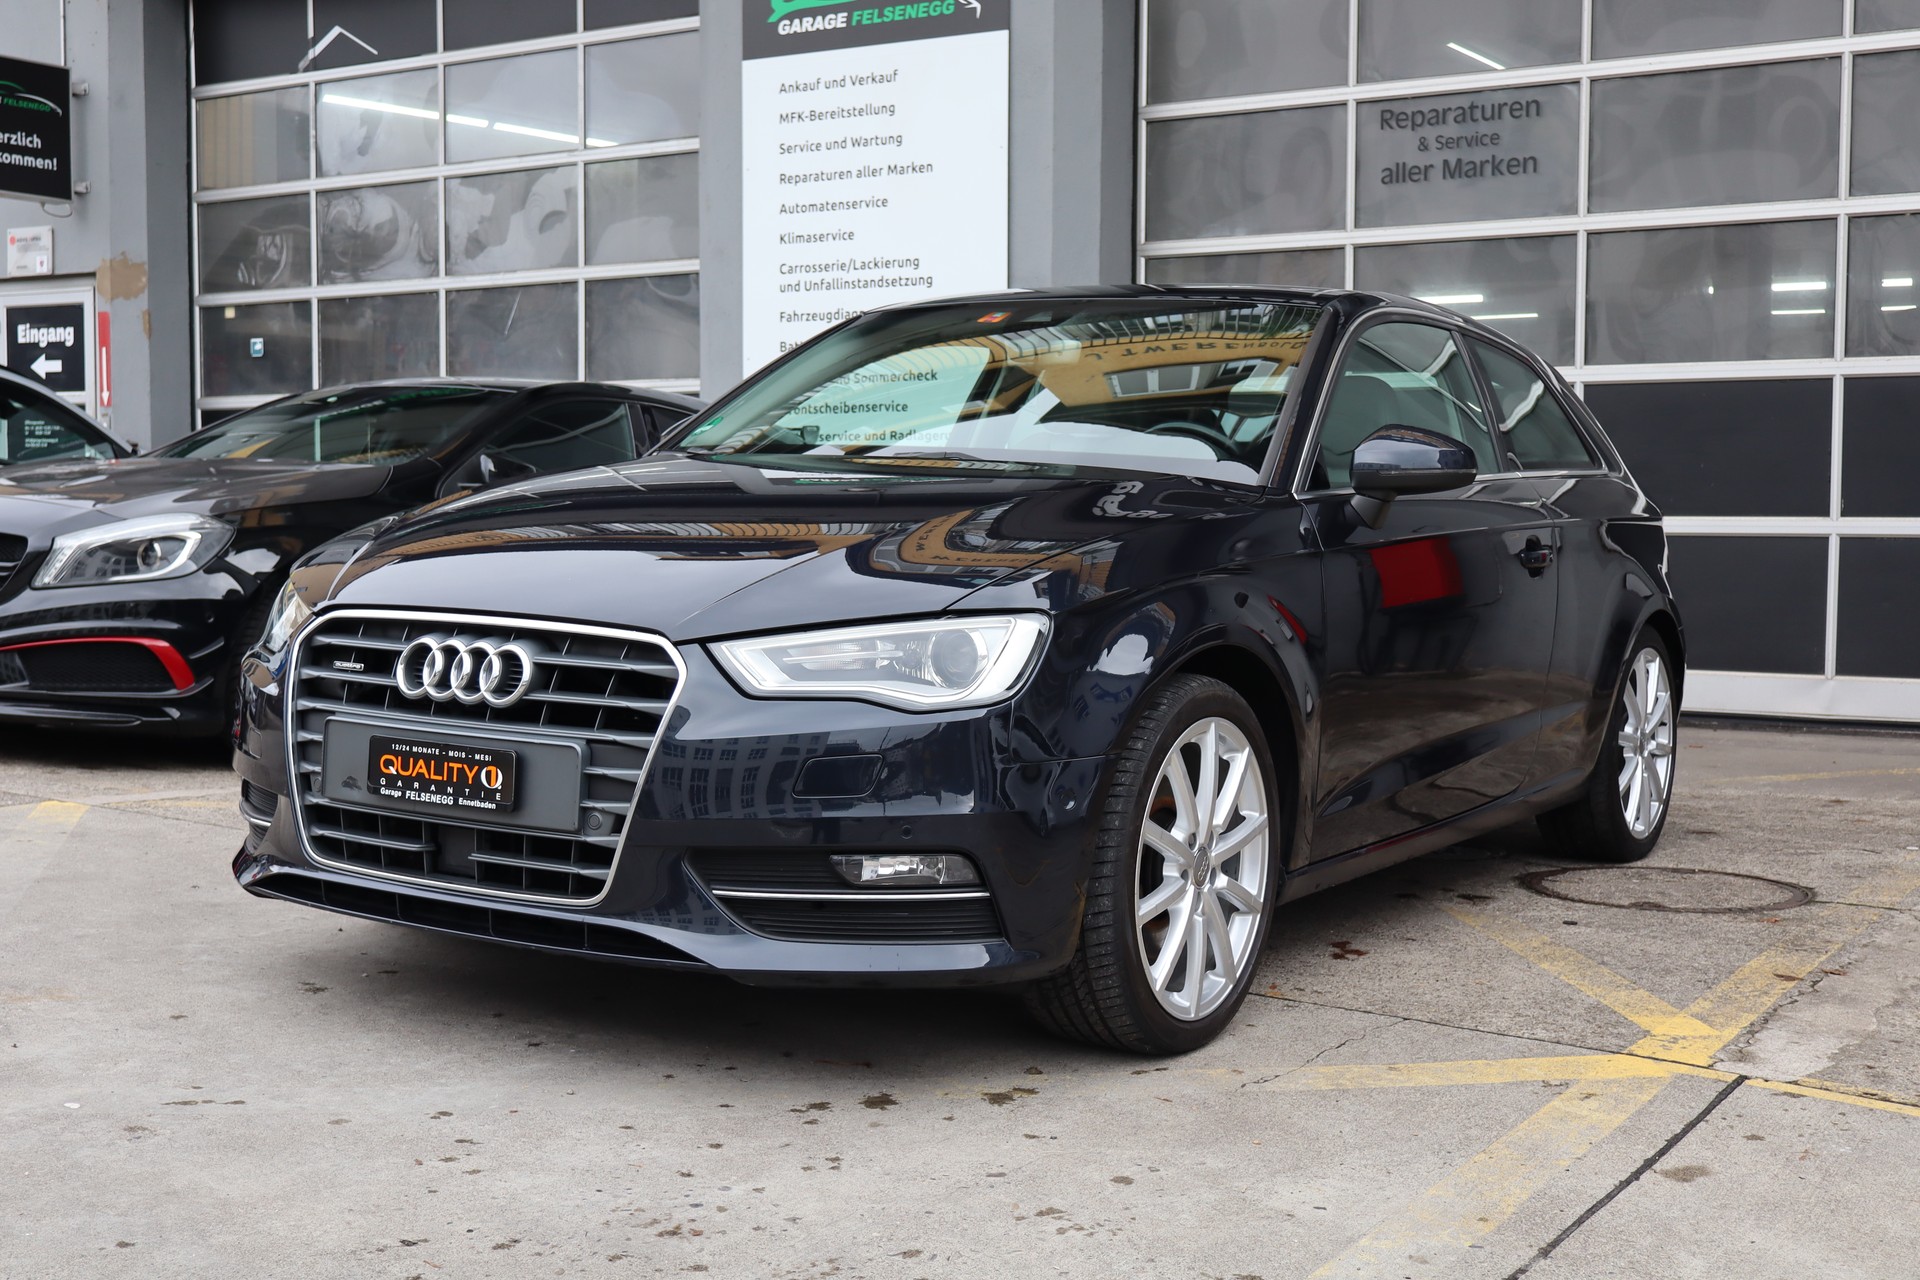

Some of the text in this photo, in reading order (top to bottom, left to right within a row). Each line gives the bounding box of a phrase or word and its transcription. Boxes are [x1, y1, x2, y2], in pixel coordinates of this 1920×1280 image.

[777, 0, 956, 36] GARAGE FELSENEGG
[778, 69, 899, 94] Ankauf und Verkauf
[778, 103, 896, 124] MFK-Bereitstellung
[1380, 99, 1542, 131] Reparaturen
[779, 133, 903, 155] Service und Wartung
[1417, 131, 1501, 152] & Service
[779, 162, 934, 186] Reparaturen aller Marken
[1380, 154, 1538, 185] aller Marken
[779, 196, 889, 215] Automatenservice
[779, 229, 855, 245] Klimaservice
[779, 257, 920, 275] Carrosserie/Lackierung
[779, 275, 934, 293] und Unfallinstandsetzung
[17, 322, 75, 348] Eingang
[854, 369, 938, 384] Sommercheck
[788, 401, 909, 416] ontscheibenservice
[818, 430, 860, 442] service
[864, 430, 887, 441] und
[391, 744, 410, 752] 12/24
[412, 746, 440, 756] MONATE
[448, 750, 466, 759] MOIS
[474, 753, 492, 762] MESI
[380, 754, 479, 785] QUALITY
[380, 777, 501, 801] GARANTIE
[380, 787, 497, 810] Garage FELSENEGG Ennetbaden
